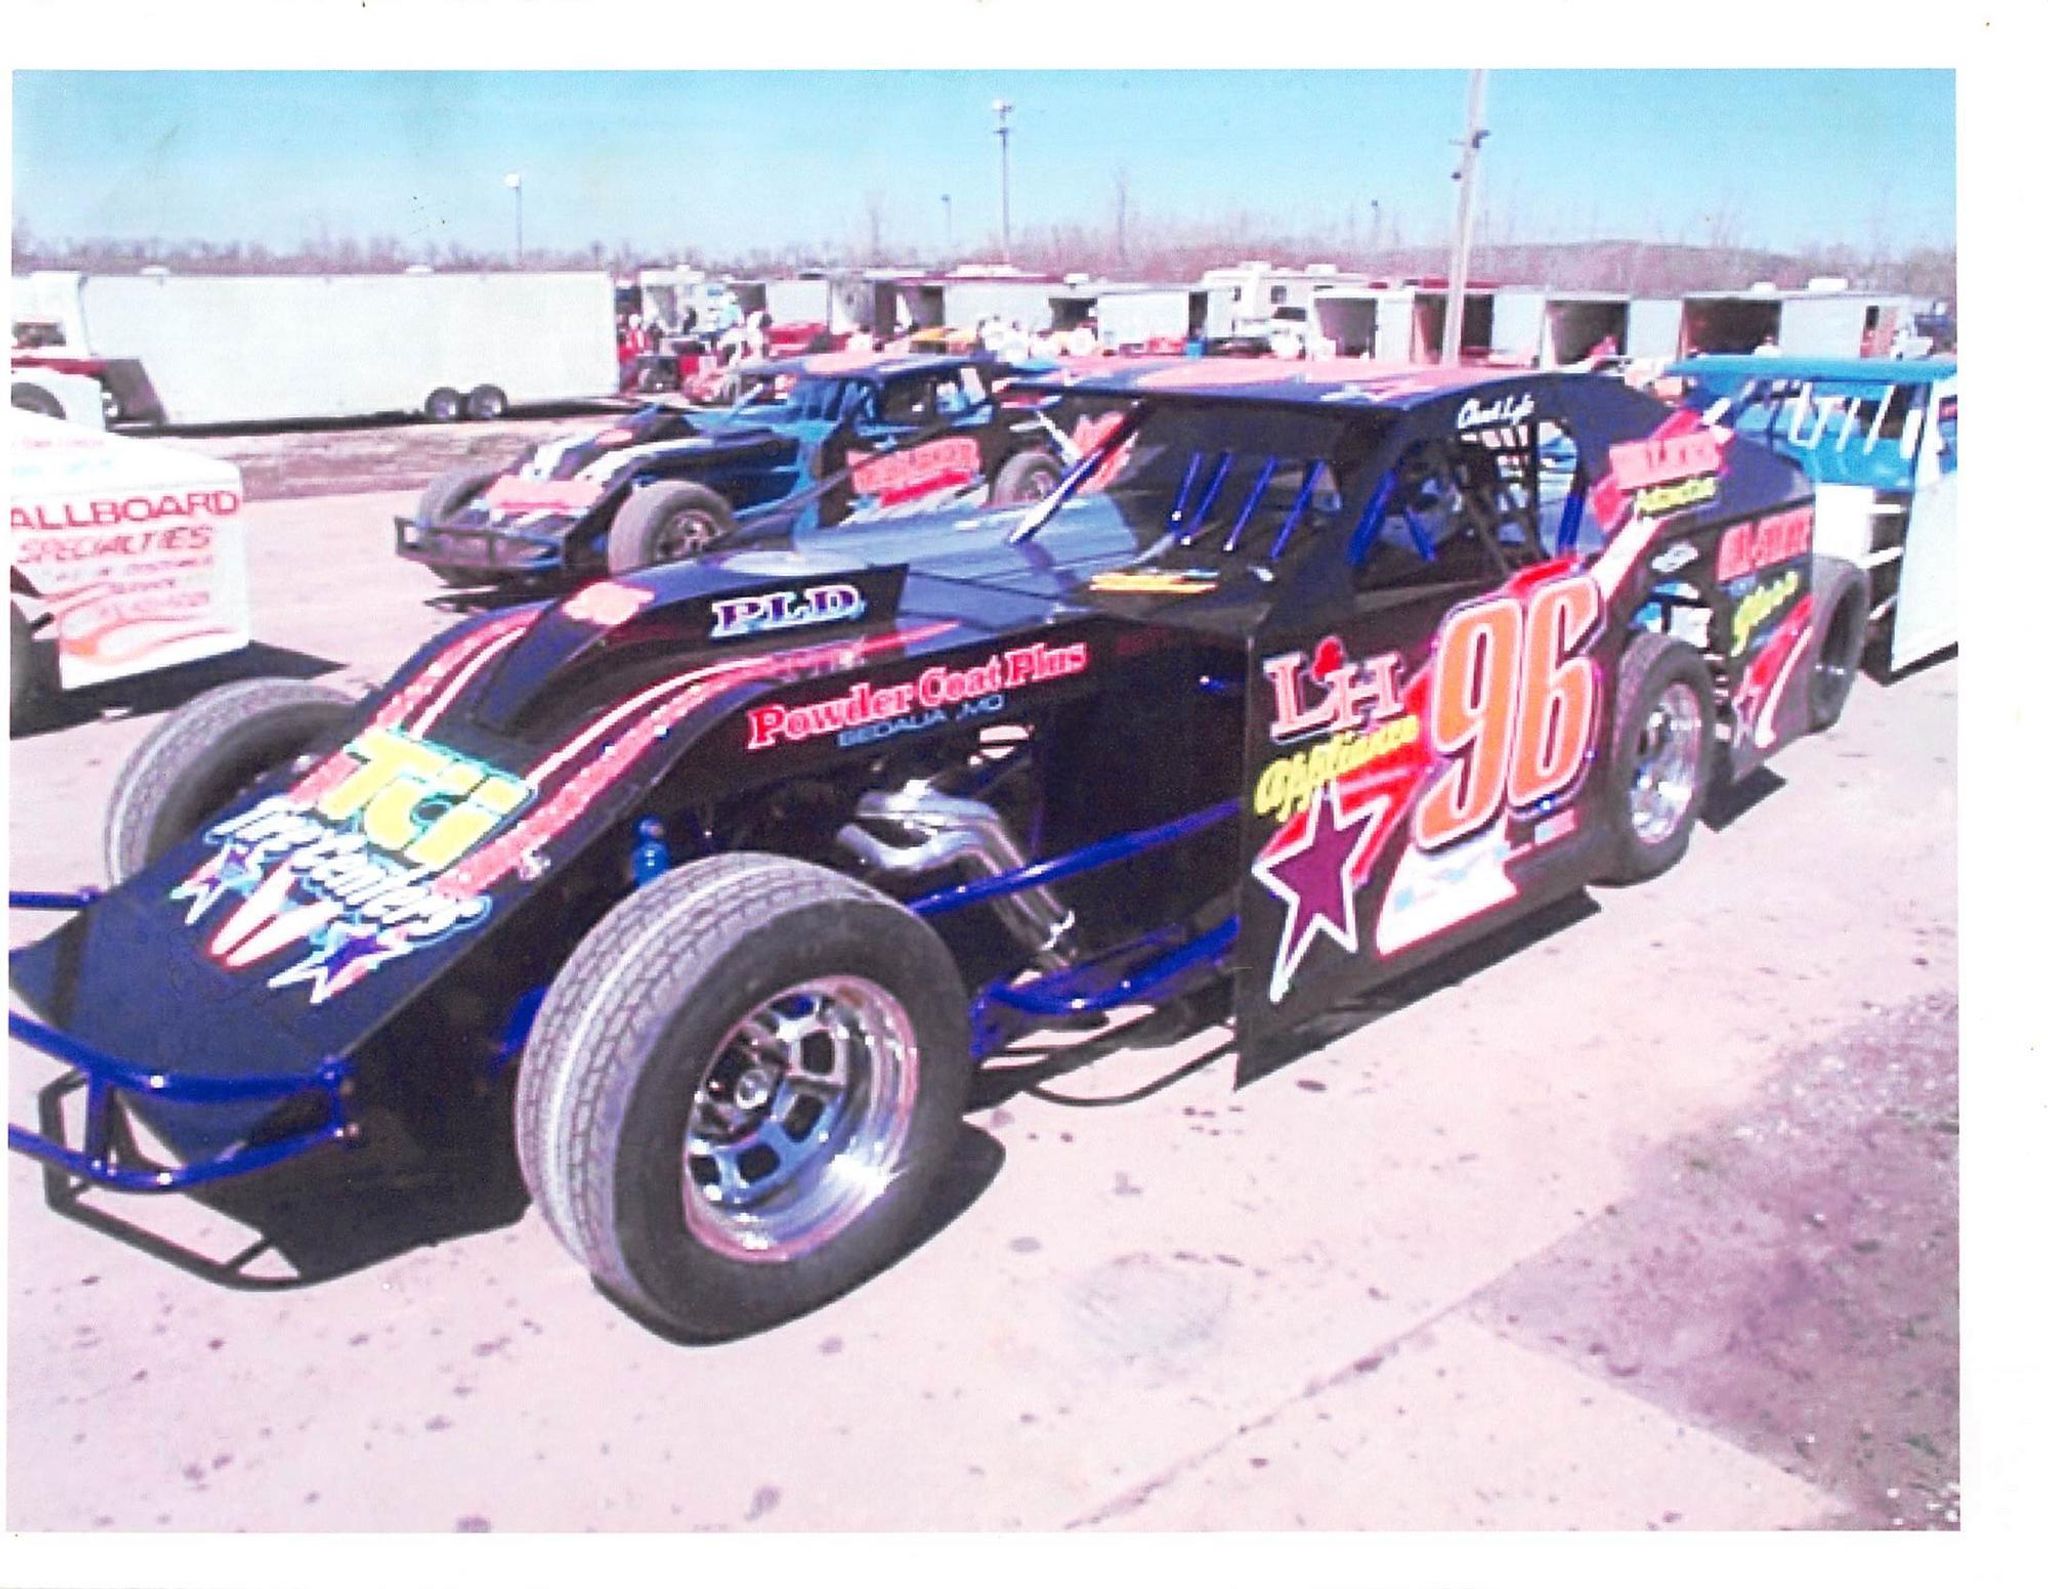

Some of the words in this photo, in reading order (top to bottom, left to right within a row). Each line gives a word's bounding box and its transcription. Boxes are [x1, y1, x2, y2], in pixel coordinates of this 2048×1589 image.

[710, 584, 866, 638] PLD
[747, 682, 914, 751] Powder
[917, 653, 1002, 707] Coat
[1003, 641, 1088, 688] Plus
[1414, 570, 1610, 854] 96
